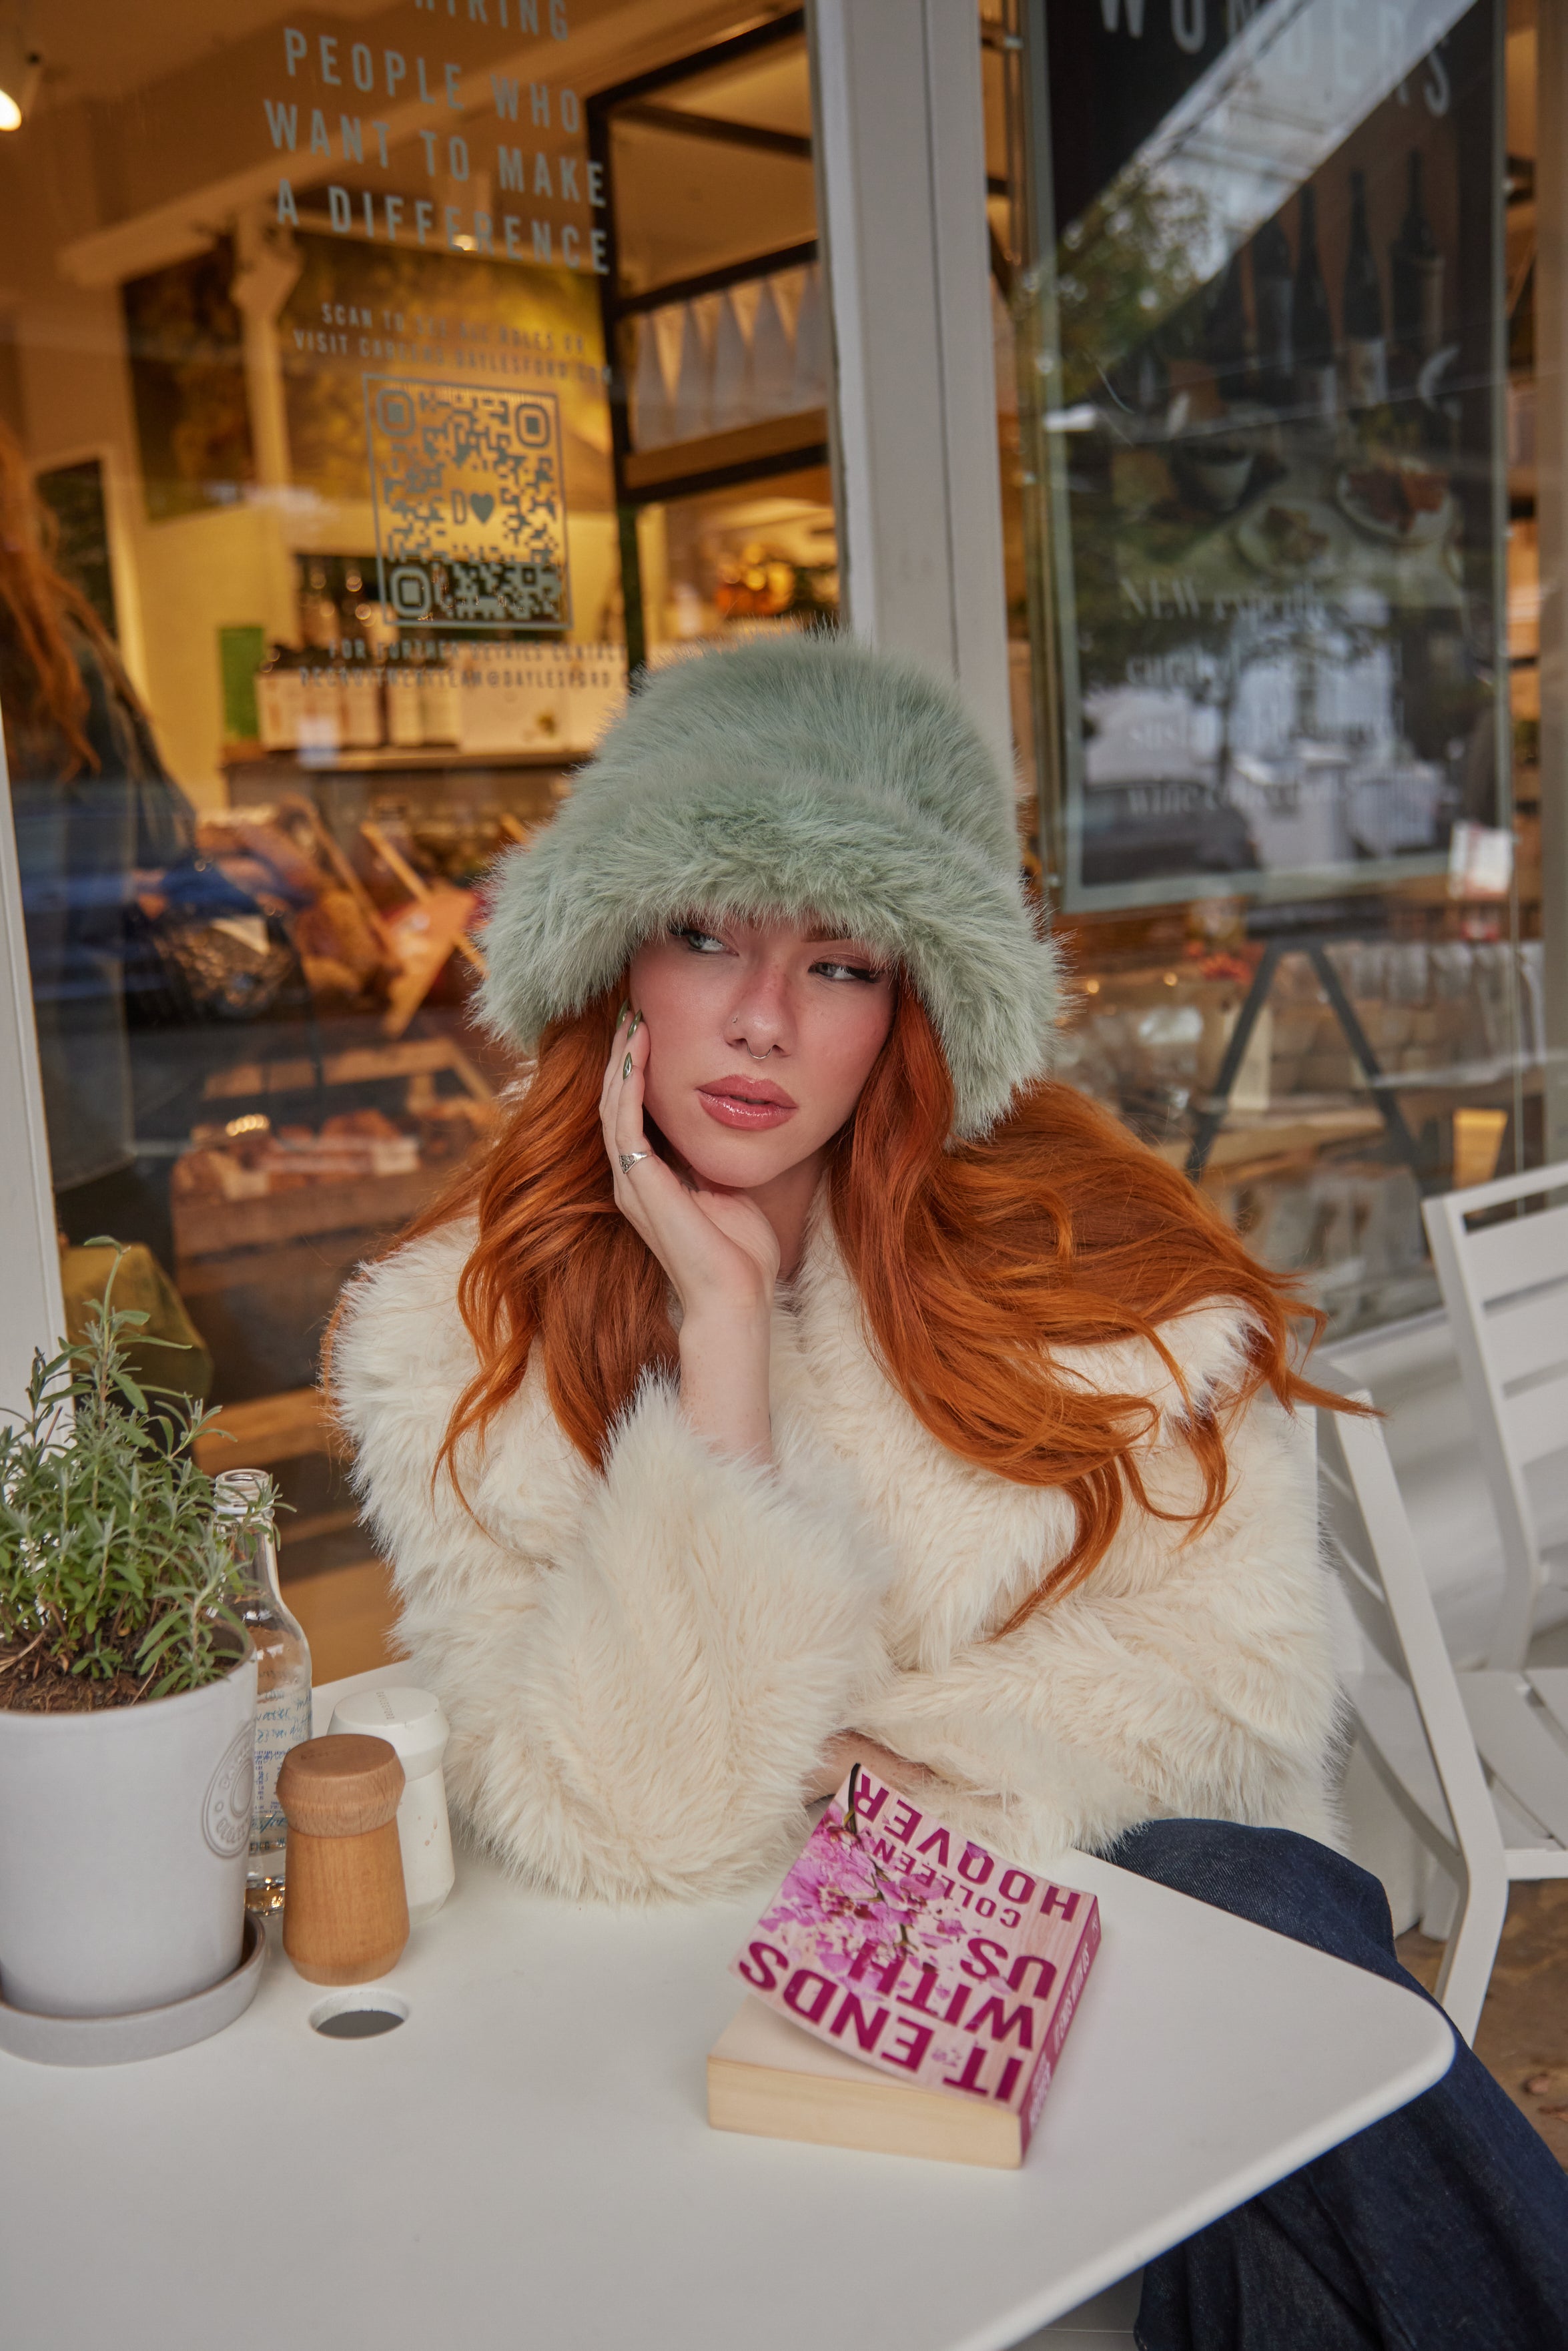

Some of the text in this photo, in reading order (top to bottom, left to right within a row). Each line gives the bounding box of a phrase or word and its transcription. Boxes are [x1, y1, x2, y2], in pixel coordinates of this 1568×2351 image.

[415, 0, 569, 41] RING
[284, 28, 580, 133] PEOPLE WHO
[264, 99, 607, 208] WANT TO MAKE
[277, 178, 610, 275] A DIFFERENCE
[294, 329, 348, 356] VISIT
[322, 302, 373, 329] SCAN
[382, 310, 404, 332] TO
[329, 638, 366, 661] FOR
[855, 1773, 1081, 1923] HOOVER
[873, 1838, 1022, 1929] COLLEEN
[738, 1941, 935, 2073] ENDS
[848, 1939, 1035, 2051] WITH
[960, 1937, 1058, 2001] US
[943, 2045, 1024, 2103] IT
